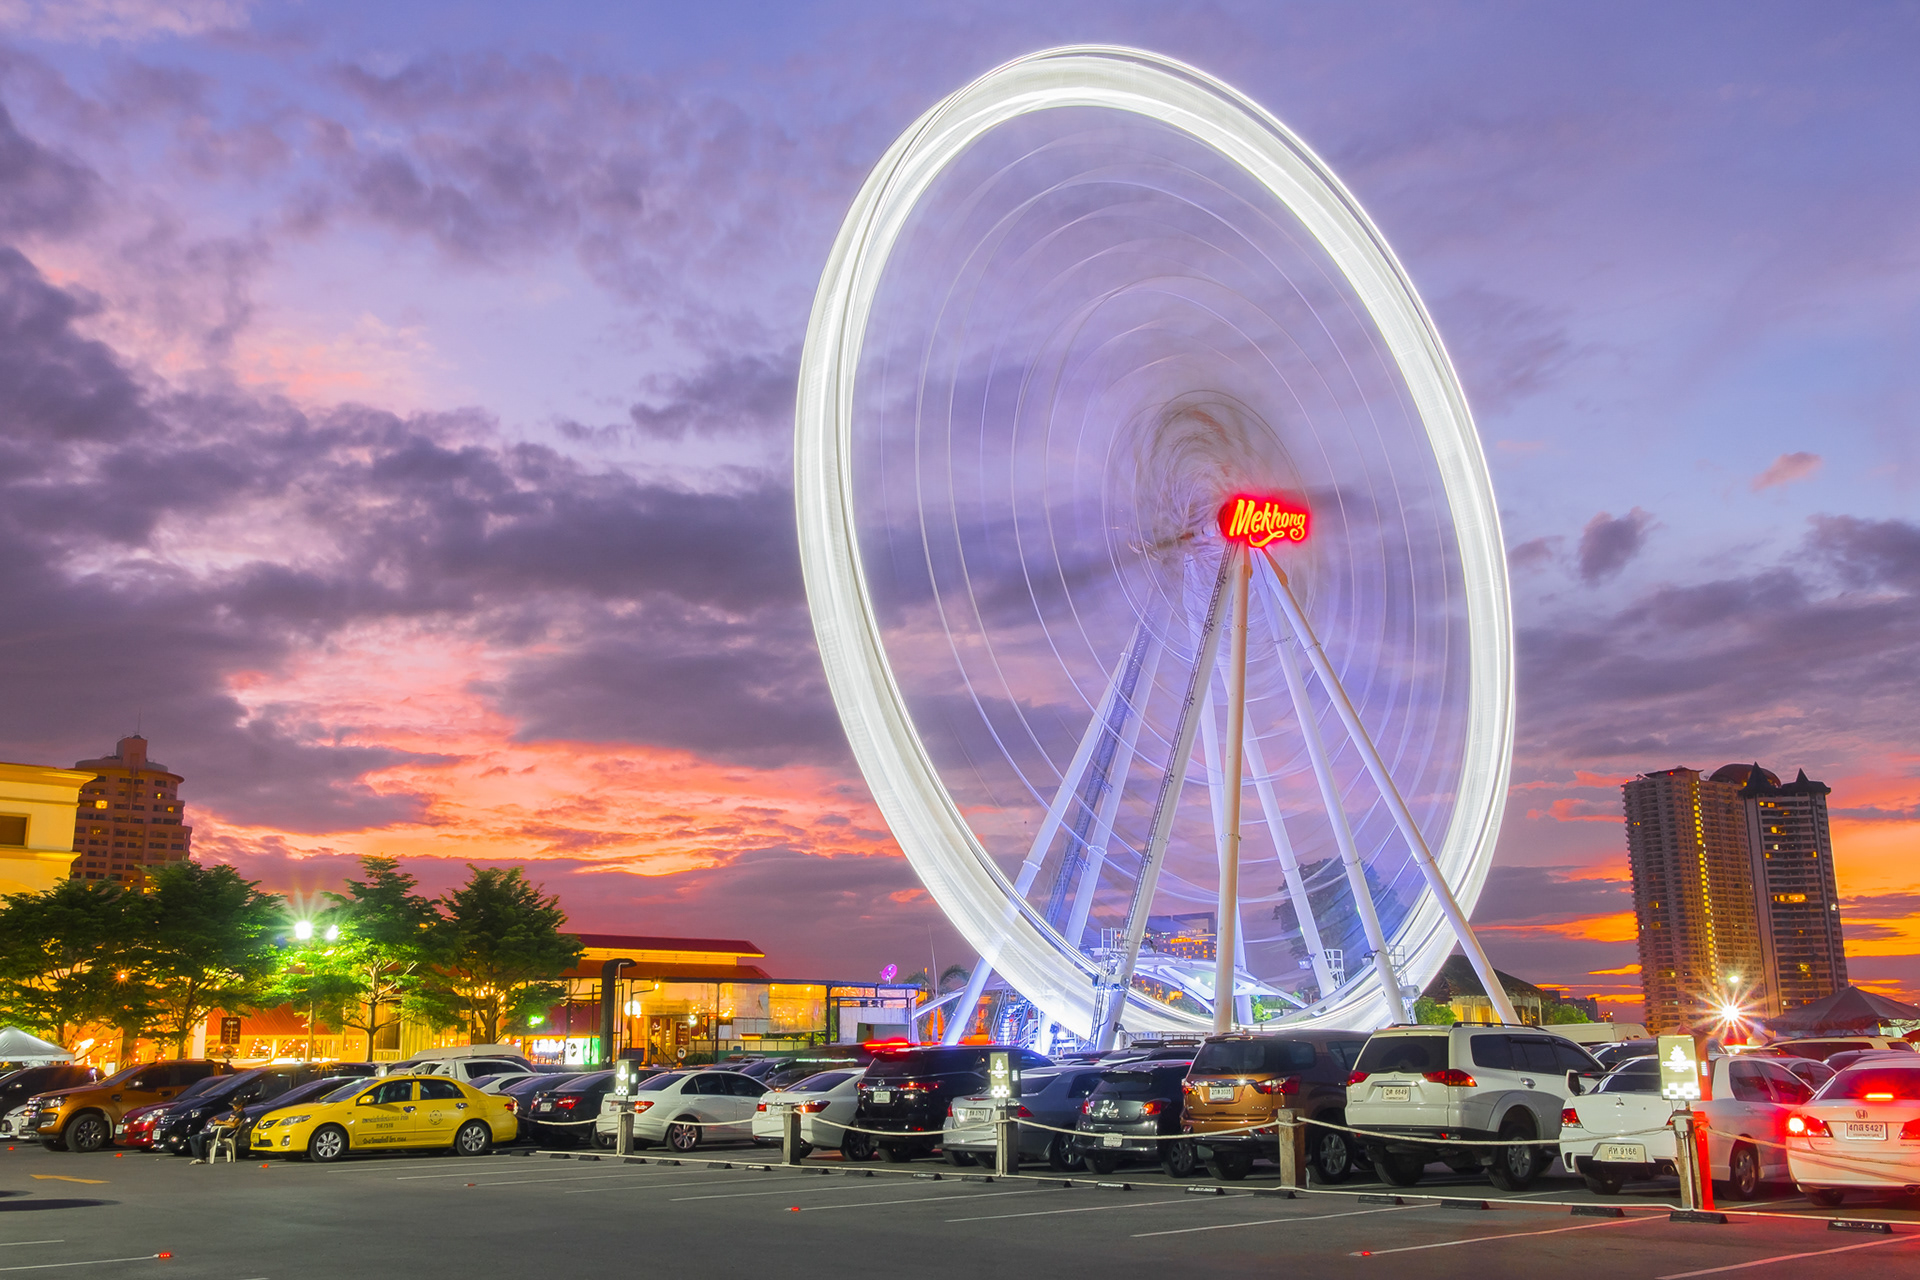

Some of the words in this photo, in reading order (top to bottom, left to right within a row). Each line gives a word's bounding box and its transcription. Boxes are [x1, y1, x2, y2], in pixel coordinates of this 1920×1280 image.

[1229, 499, 1306, 547] Mekhong
[1866, 1123, 1883, 1131] 5427
[1620, 1147, 1636, 1155] 9166
